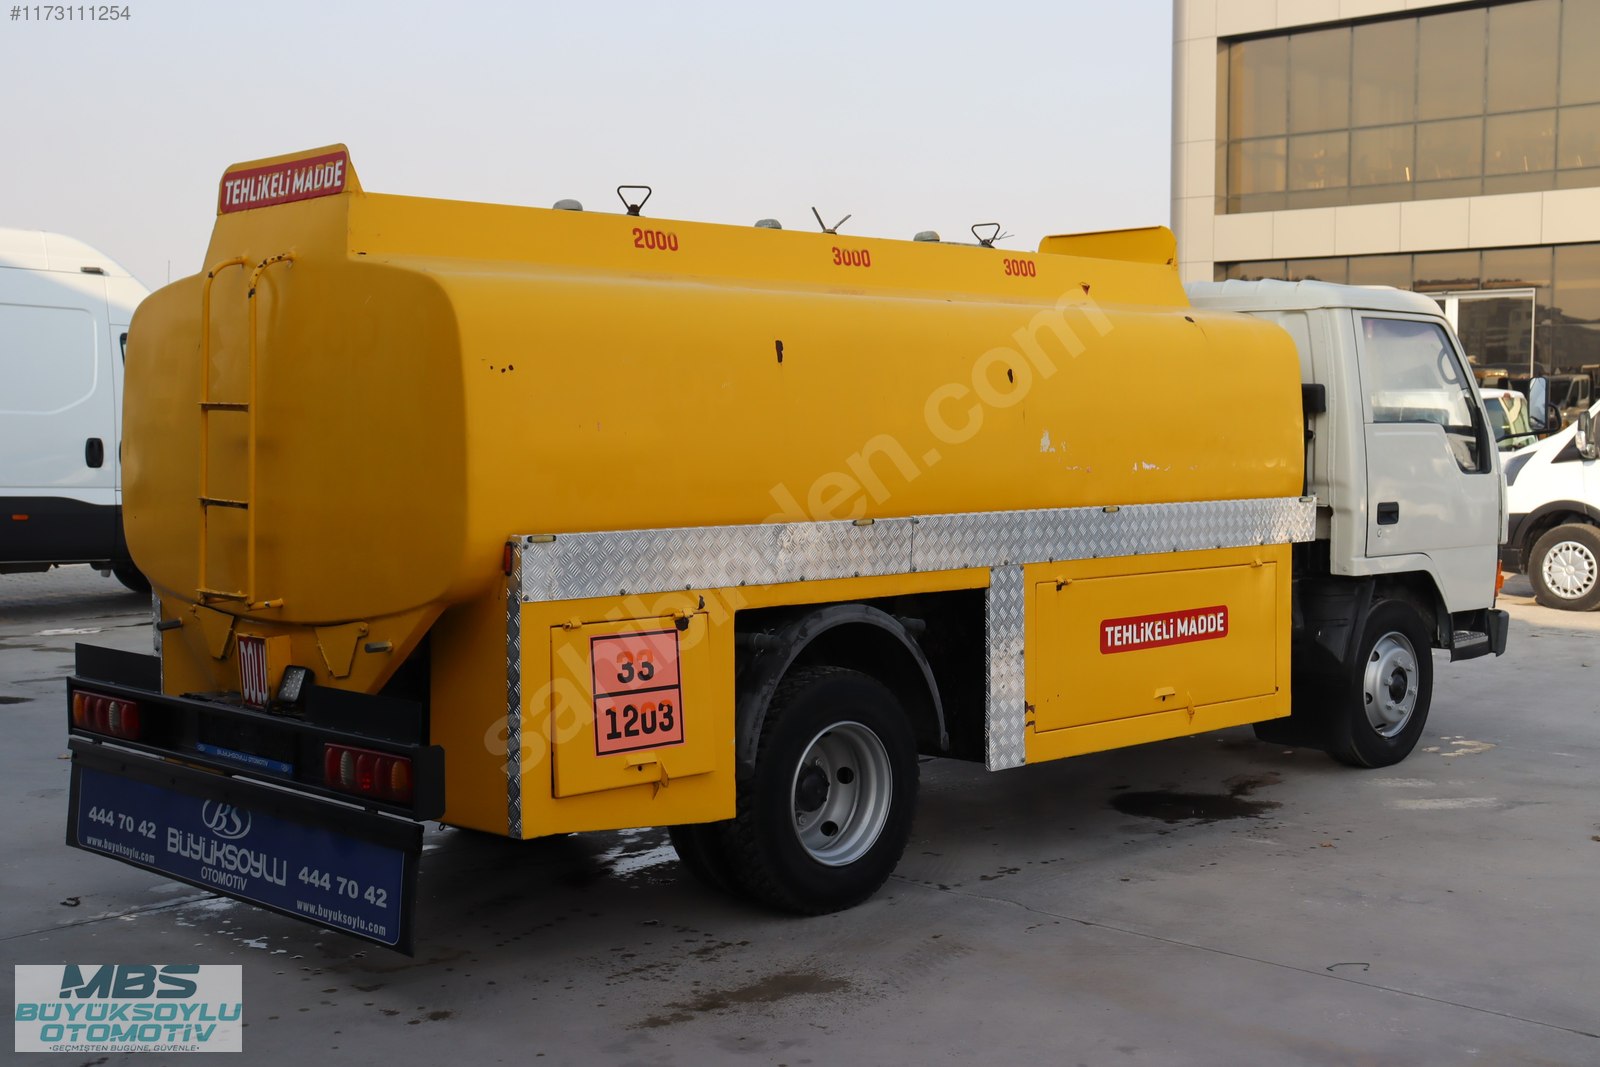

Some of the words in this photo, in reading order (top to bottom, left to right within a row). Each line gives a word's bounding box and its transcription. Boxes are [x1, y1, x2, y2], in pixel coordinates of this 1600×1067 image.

[292, 160, 344, 194] MADDE
[632, 227, 679, 252] 2000
[832, 246, 871, 268] 3000
[1003, 257, 1036, 278] 3000
[1177, 612, 1225, 637] MADDE
[240, 641, 268, 704] DOLU
[616, 649, 655, 684] 33
[605, 699, 674, 740] 1203
[88, 806, 114, 827] 444
[118, 813, 134, 832] 70
[138, 820, 157, 839] 42
[86, 835, 155, 864] www.buyuksoylu.com
[298, 866, 331, 891] 444
[336, 876, 359, 900] 70
[364, 885, 388, 909] 42
[296, 898, 386, 937] www.buyuksoylu.com
